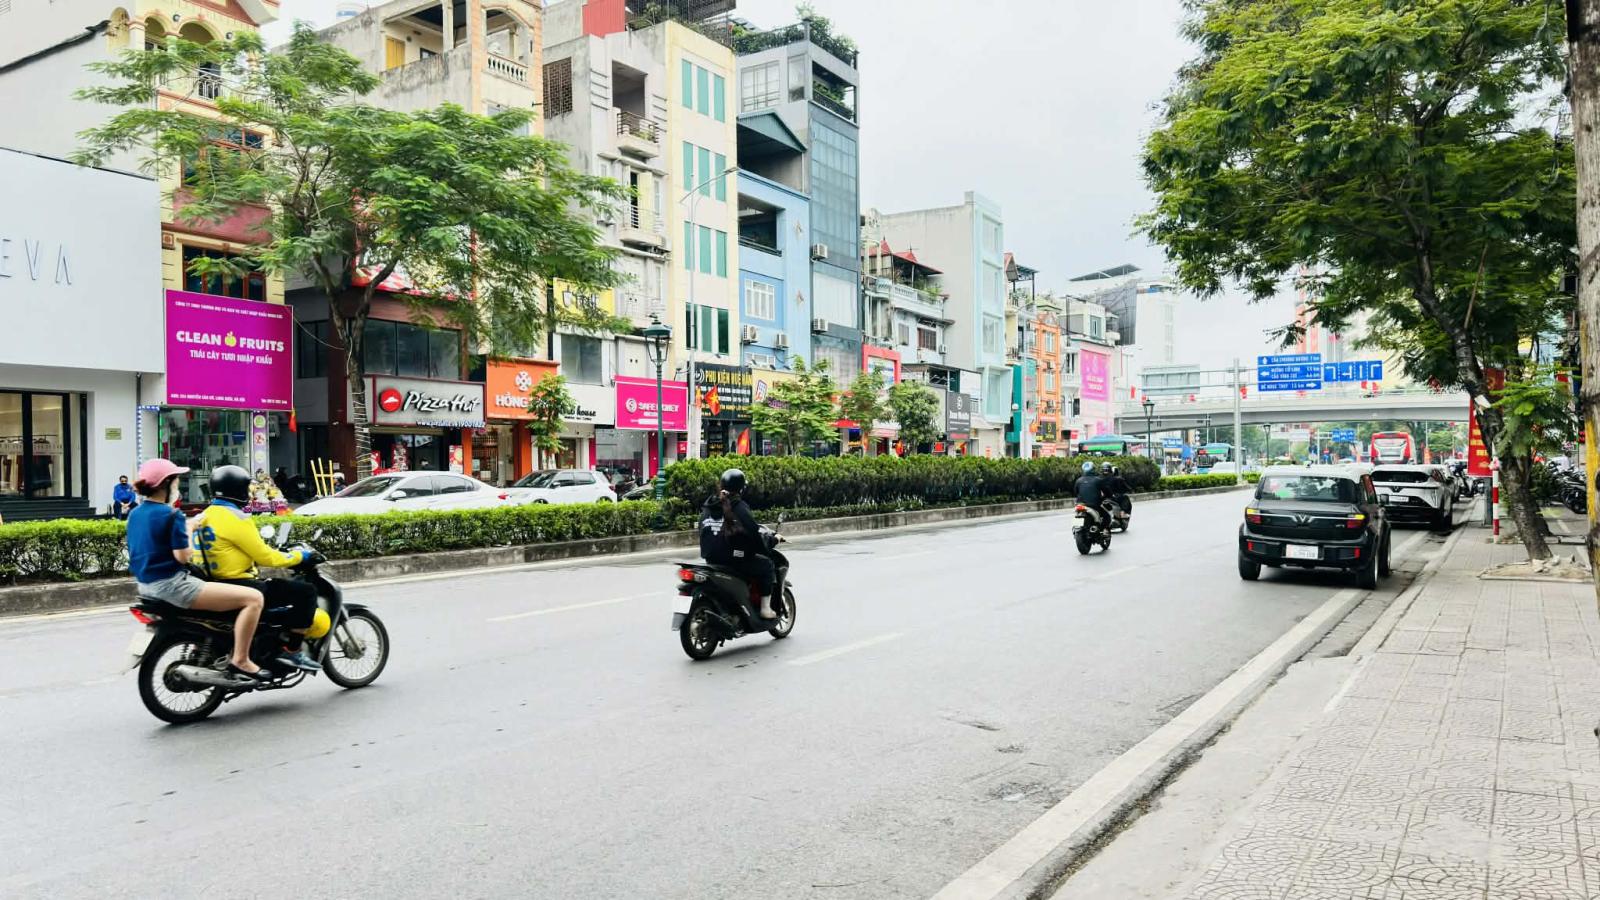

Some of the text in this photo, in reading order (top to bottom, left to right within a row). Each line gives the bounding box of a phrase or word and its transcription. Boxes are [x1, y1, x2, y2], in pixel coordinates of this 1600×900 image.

[176, 330, 285, 352] CLEAN FRUITS
[403, 390, 480, 412] Pizza Hut
